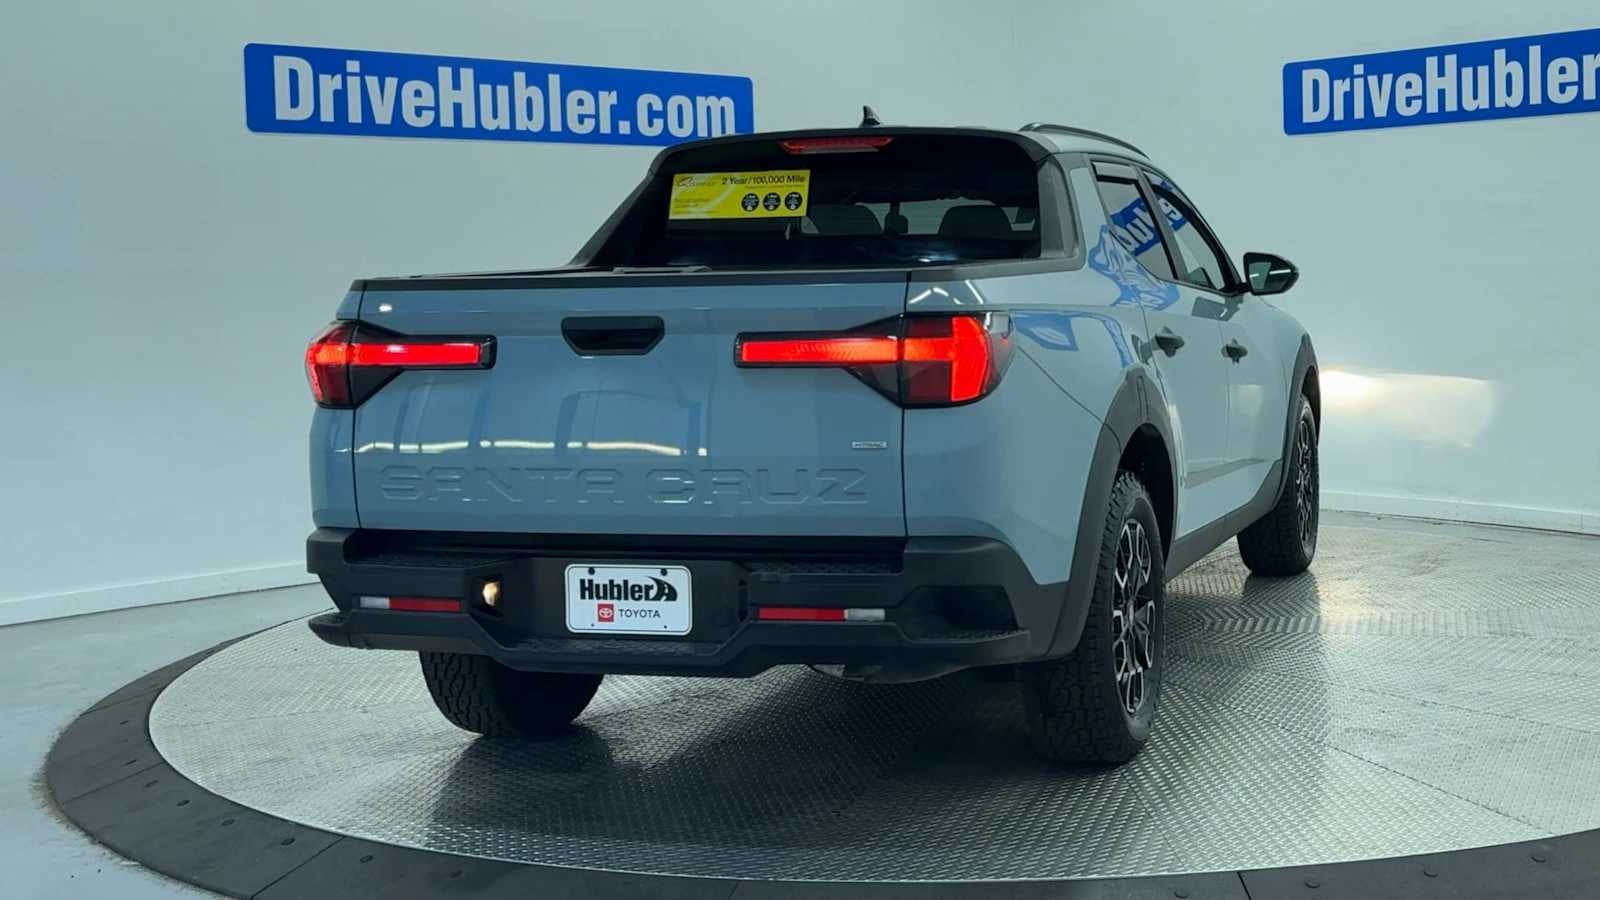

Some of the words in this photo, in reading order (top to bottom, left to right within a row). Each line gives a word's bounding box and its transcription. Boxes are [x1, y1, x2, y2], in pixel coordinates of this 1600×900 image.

[273, 55, 735, 138] DriveHubler.com
[1302, 45, 1600, 123] DriveHubler
[721, 177, 728, 185] 2
[786, 175, 805, 184] Mile
[381, 465, 624, 503] SANTA
[646, 467, 868, 504] CRUZ
[579, 578, 654, 601] Hubler
[618, 608, 661, 618] TOYOTA
